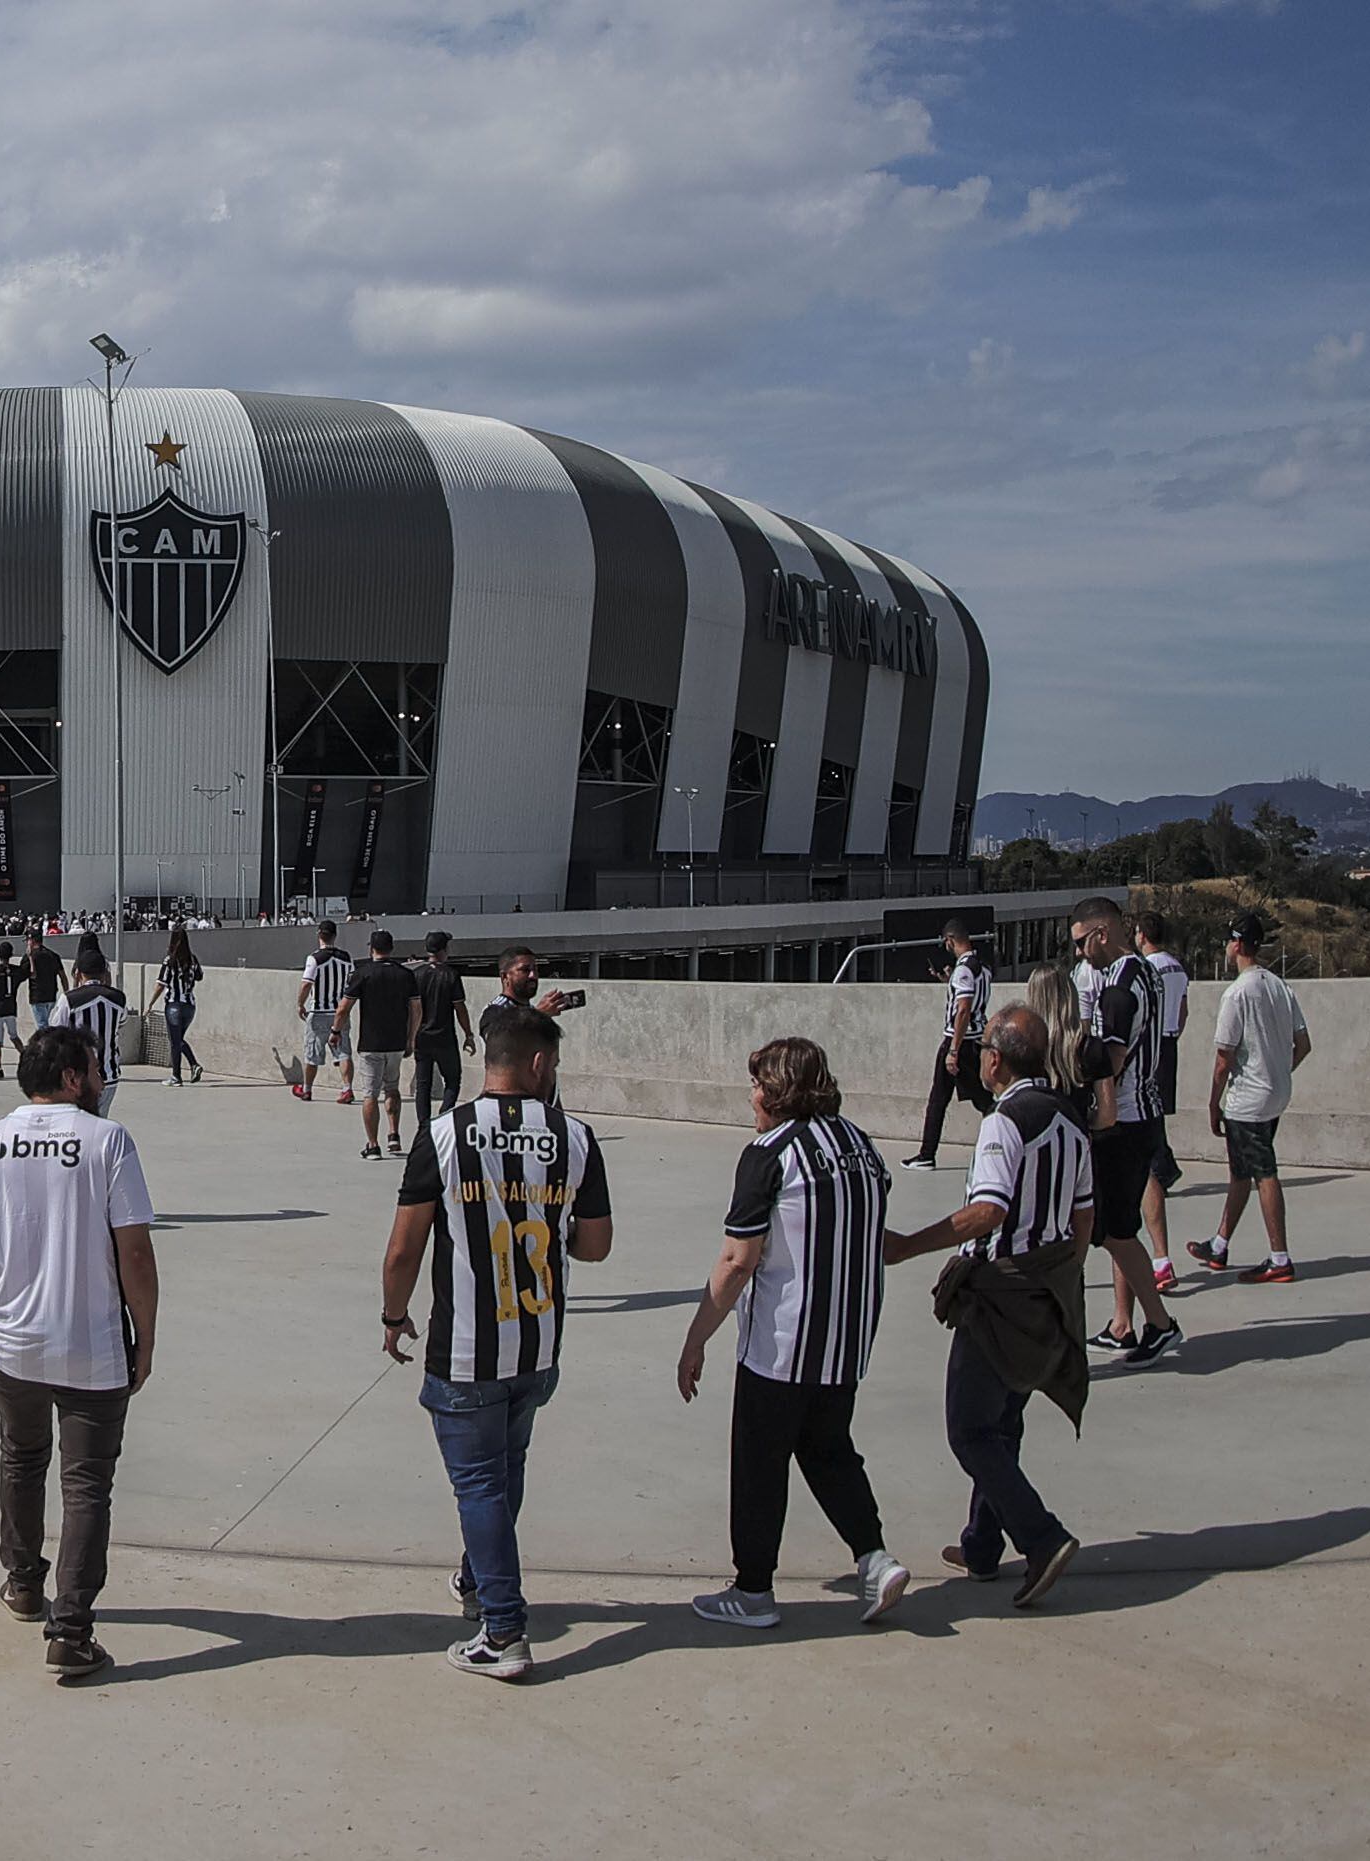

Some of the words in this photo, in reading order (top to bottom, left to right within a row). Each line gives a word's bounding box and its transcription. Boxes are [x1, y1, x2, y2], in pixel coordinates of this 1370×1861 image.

[117, 527, 221, 554] CAM
[368, 809, 377, 831] GALO
[0, 833, 6, 845] DO
[0, 864, 7, 872] O
[47, 1130, 77, 1139] banco
[490, 1126, 555, 1163] bmg
[11, 1133, 83, 1168] bmg
[452, 1179, 493, 1204] LUIZ
[498, 1179, 577, 1206] SALOMÃO
[491, 1220, 554, 1322] 13
